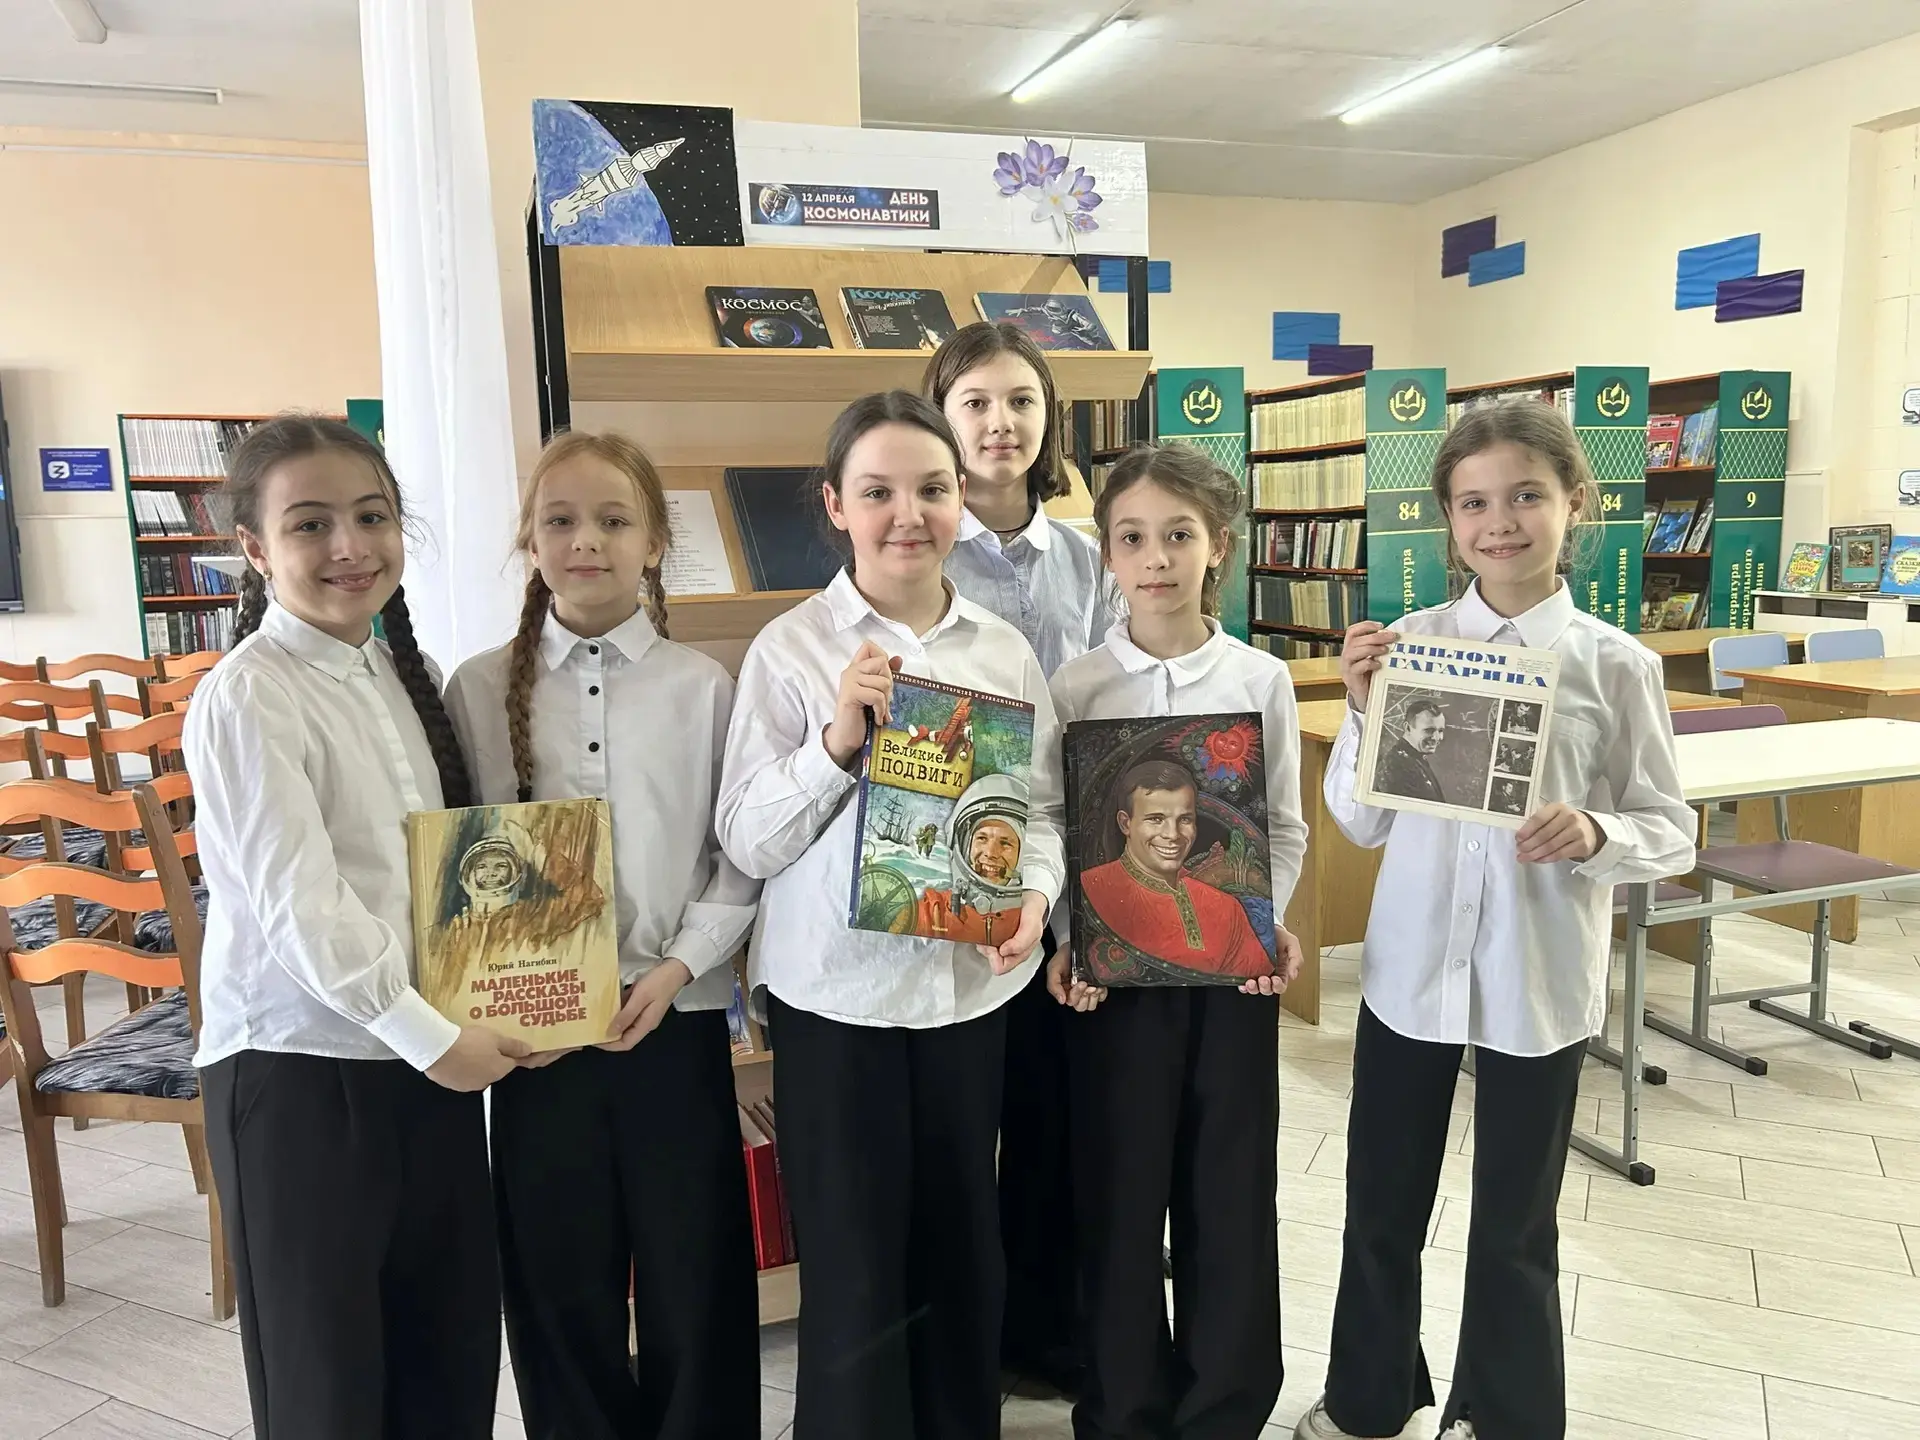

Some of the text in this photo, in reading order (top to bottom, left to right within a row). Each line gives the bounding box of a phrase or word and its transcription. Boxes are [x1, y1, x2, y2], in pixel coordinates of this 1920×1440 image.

[801, 191, 929, 206] 12 АПРЕЛЯ ДЕНЬ
[804, 206, 930, 223] КОСМОНАВТИКИ
[721, 297, 804, 311] КОСМОС
[1602, 493, 1622, 512] 84
[1746, 491, 1757, 509] 9
[1398, 501, 1421, 521] 84
[1617, 547, 1628, 595] поэзия
[1391, 643, 1507, 666] ДИПЛОМ
[1388, 657, 1549, 688] ГАГАРИНА
[882, 738, 944, 764] Великие
[880, 756, 964, 788] ПОДВИГИ
[488, 958, 558, 973] Юрий Нагибин
[471, 968, 579, 994] МАЛЕНЬКИЕ
[493, 981, 586, 1004] РАССКАЗЫ
[469, 994, 580, 1020] О БОЛЬШОЙ
[519, 1007, 587, 1027] СУДЬБЕ
